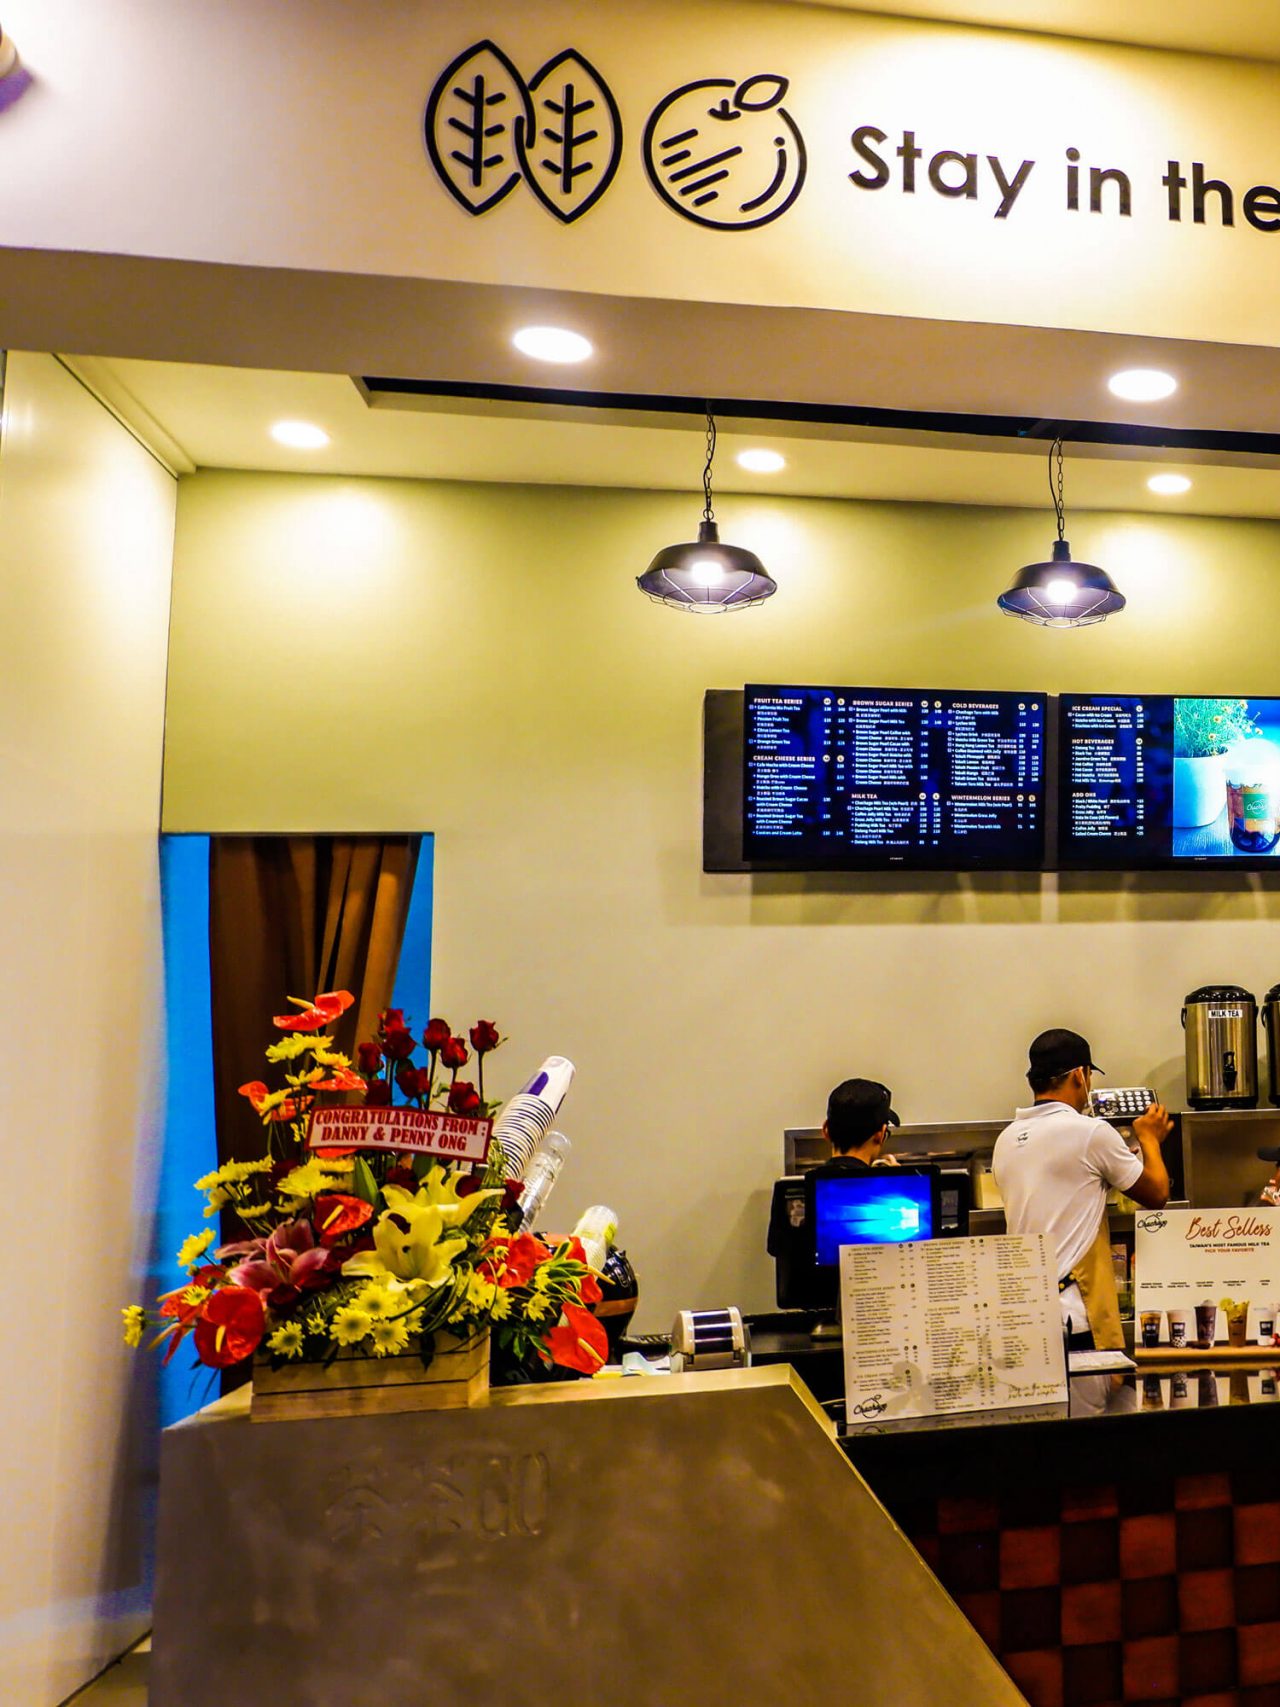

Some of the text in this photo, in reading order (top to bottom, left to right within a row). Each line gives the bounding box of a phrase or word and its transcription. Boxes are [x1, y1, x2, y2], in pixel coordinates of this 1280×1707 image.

[847, 124, 1036, 220] Stay
[1064, 146, 1132, 217] in
[1210, 1010, 1240, 1018] MILK TEA
[315, 1110, 438, 1130] CONGRATULATIONS
[442, 1118, 478, 1135] FROM
[321, 1126, 467, 1151] DANNY & PENNY ONG
[1185, 1216, 1272, 1240] Best Sellers
